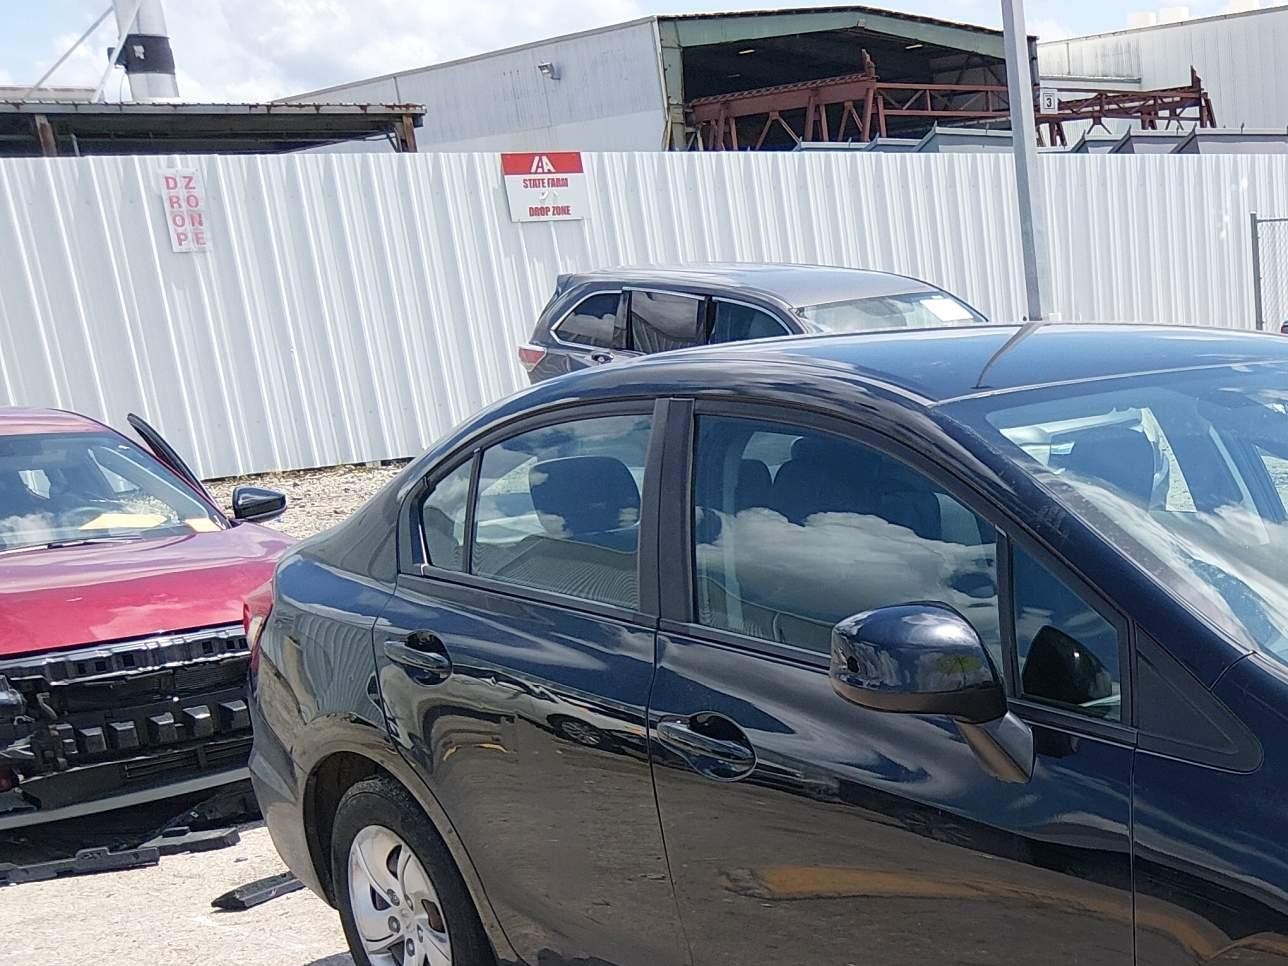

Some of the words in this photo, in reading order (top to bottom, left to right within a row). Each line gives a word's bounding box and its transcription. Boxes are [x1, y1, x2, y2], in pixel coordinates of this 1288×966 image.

[1046, 97, 1052, 108] 3
[522, 178, 546, 189] STATE
[547, 177, 569, 188] FARM
[528, 206, 551, 217] DROP
[552, 205, 571, 216] ZONE
